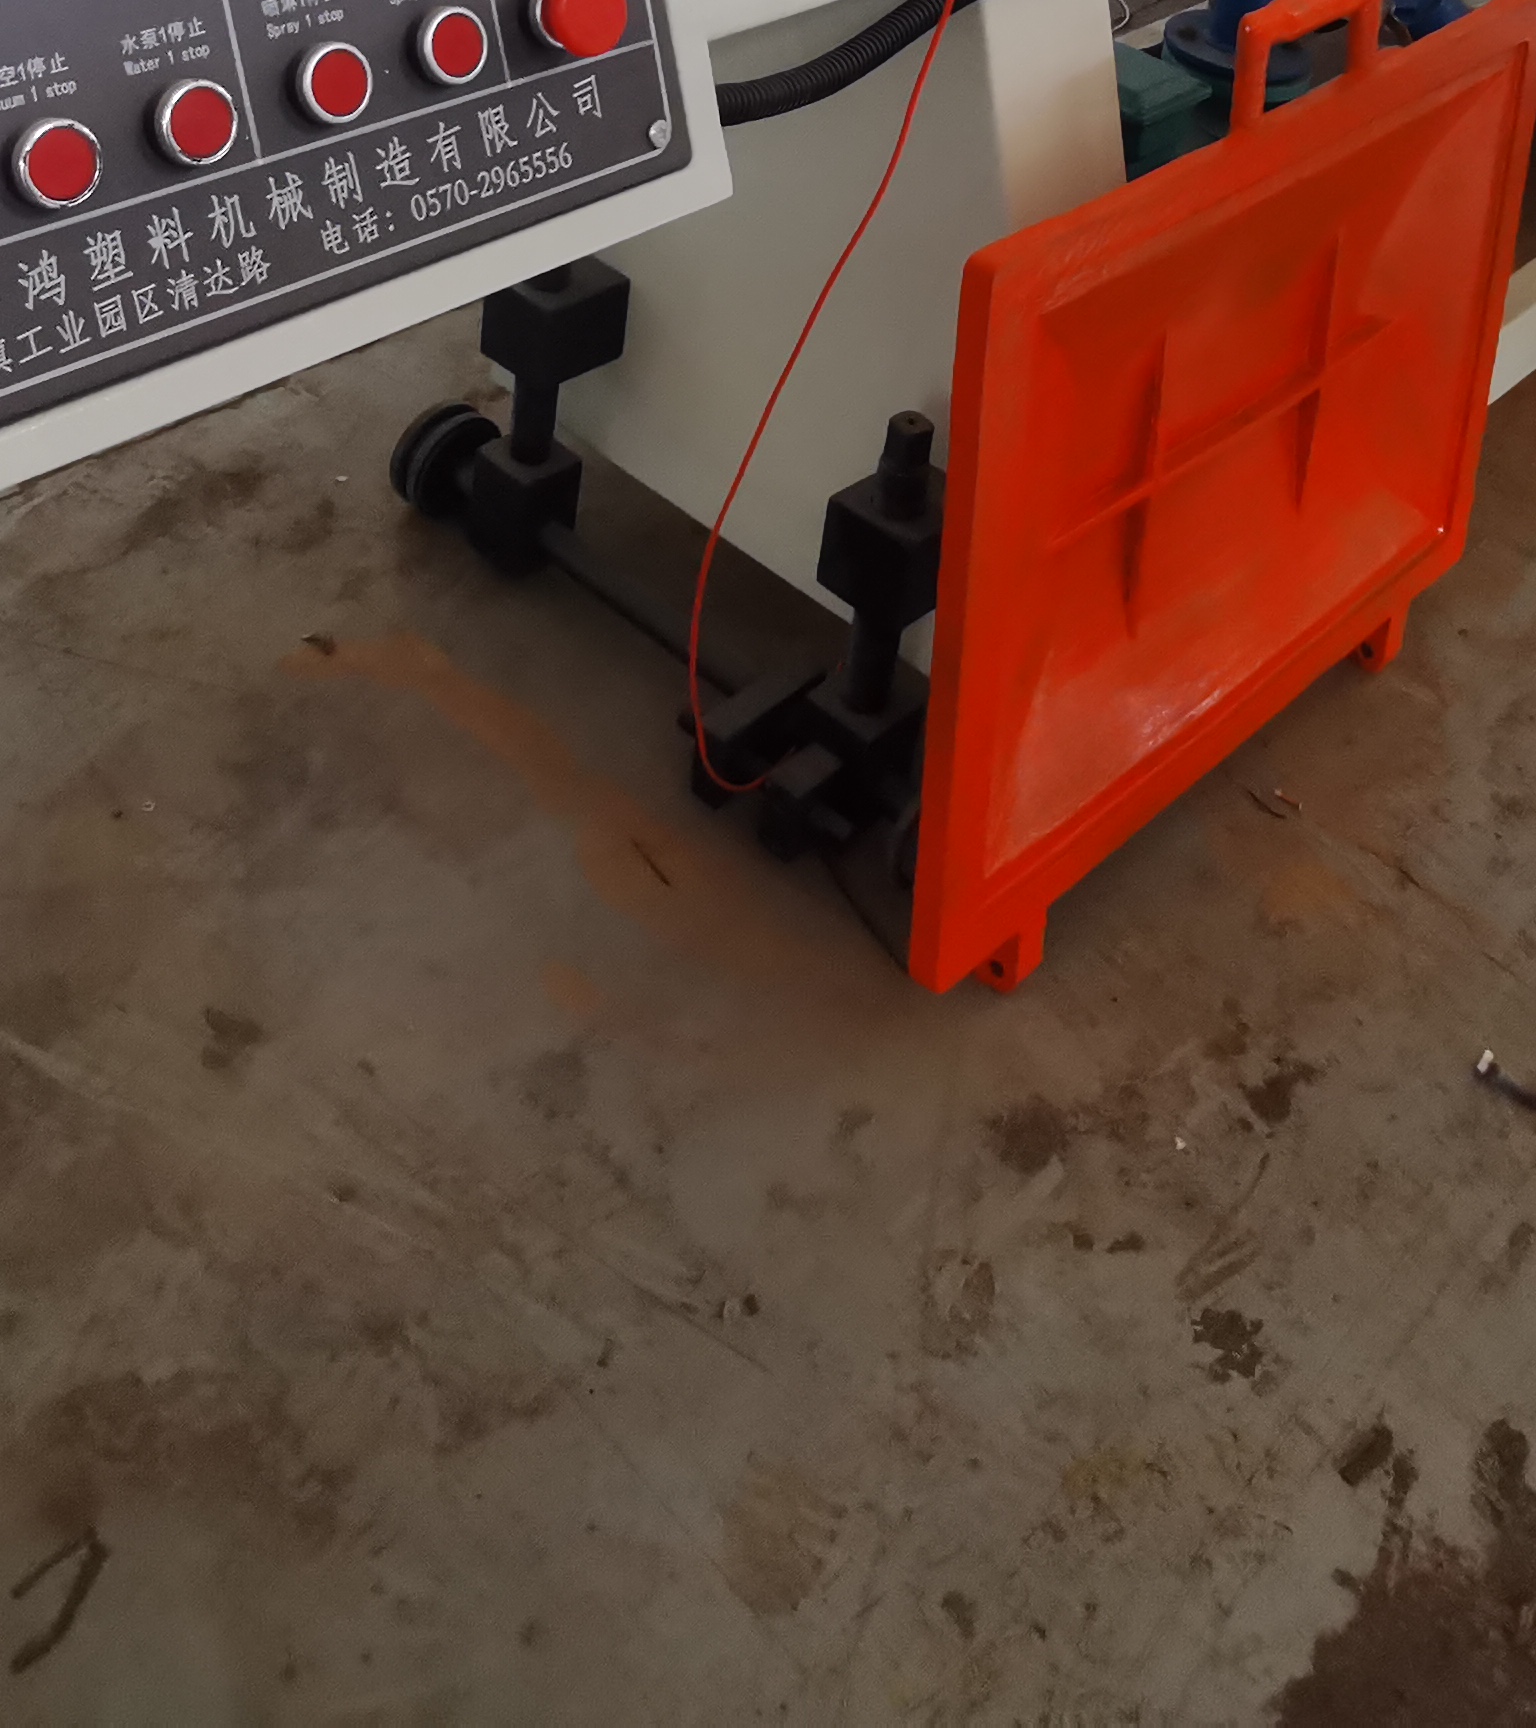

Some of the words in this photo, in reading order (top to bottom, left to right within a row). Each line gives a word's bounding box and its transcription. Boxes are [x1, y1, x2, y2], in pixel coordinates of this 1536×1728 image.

[120, 16, 207, 56] 水泵1停止
[266, 18, 300, 40] Spray
[305, 12, 312, 27] 1
[317, 7, 344, 24] stop
[123, 56, 160, 76] Water
[168, 51, 175, 66] 1
[181, 43, 210, 63] stop
[31, 87, 38, 103] 1
[45, 80, 77, 100] stop
